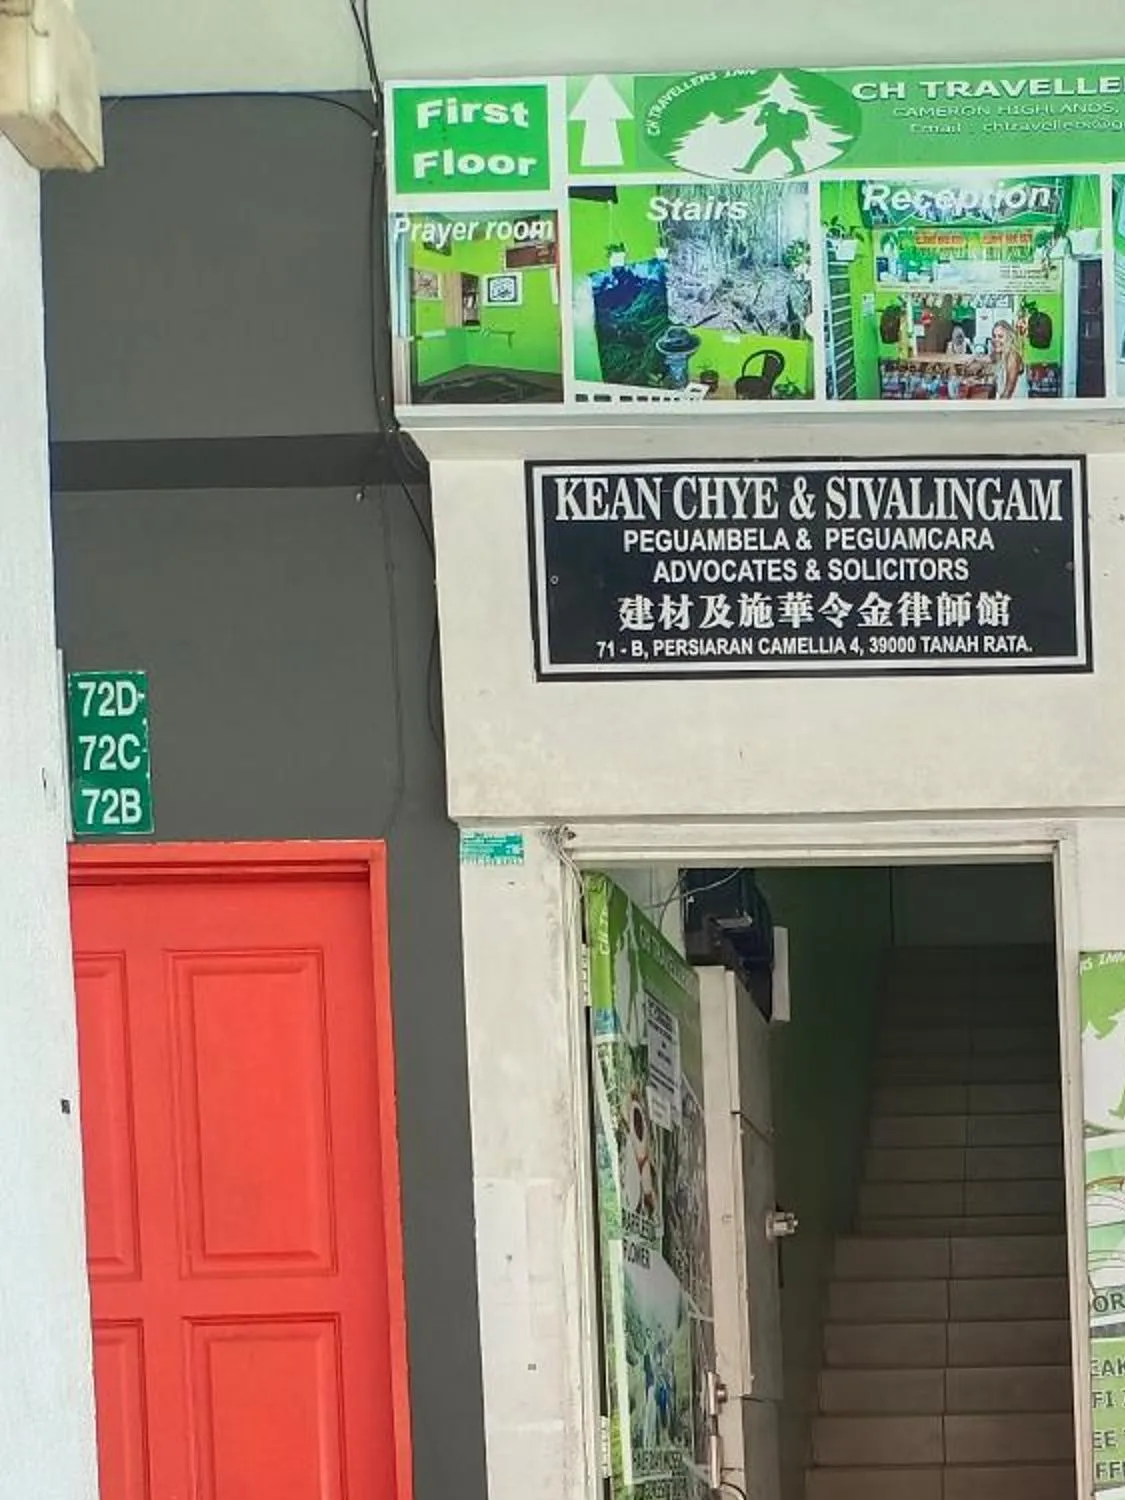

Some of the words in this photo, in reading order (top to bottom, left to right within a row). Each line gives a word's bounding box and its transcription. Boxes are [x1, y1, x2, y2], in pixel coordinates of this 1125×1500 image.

[851, 81, 906, 101] CH
[415, 96, 530, 130] First
[893, 105, 992, 118] CAMERON
[412, 148, 538, 180] Floor
[646, 196, 749, 223] Stairs
[392, 216, 482, 248] Prayer
[484, 216, 554, 244] room
[554, 476, 664, 521] KEAN
[673, 476, 780, 521] CHYE
[789, 475, 816, 520] &
[825, 475, 1063, 521] SIVALINGAM
[624, 528, 790, 553] PEGUAMBELA
[796, 529, 812, 552] &
[825, 527, 995, 551] PEGUAMCARA
[653, 559, 798, 584] ADVOCATES
[805, 559, 821, 583] &
[827, 558, 970, 583] SOLICITORS
[597, 641, 617, 660] 71
[653, 639, 752, 658] PERSIARAN
[758, 637, 847, 656] CAMELLIA
[850, 637, 864, 657] 4,
[869, 636, 917, 655] 39000
[920, 636, 979, 654] TANAH
[983, 635, 1034, 653] RATA.
[77, 680, 141, 718] 72D
[78, 734, 142, 771] 72C
[80, 788, 143, 825] 72B
